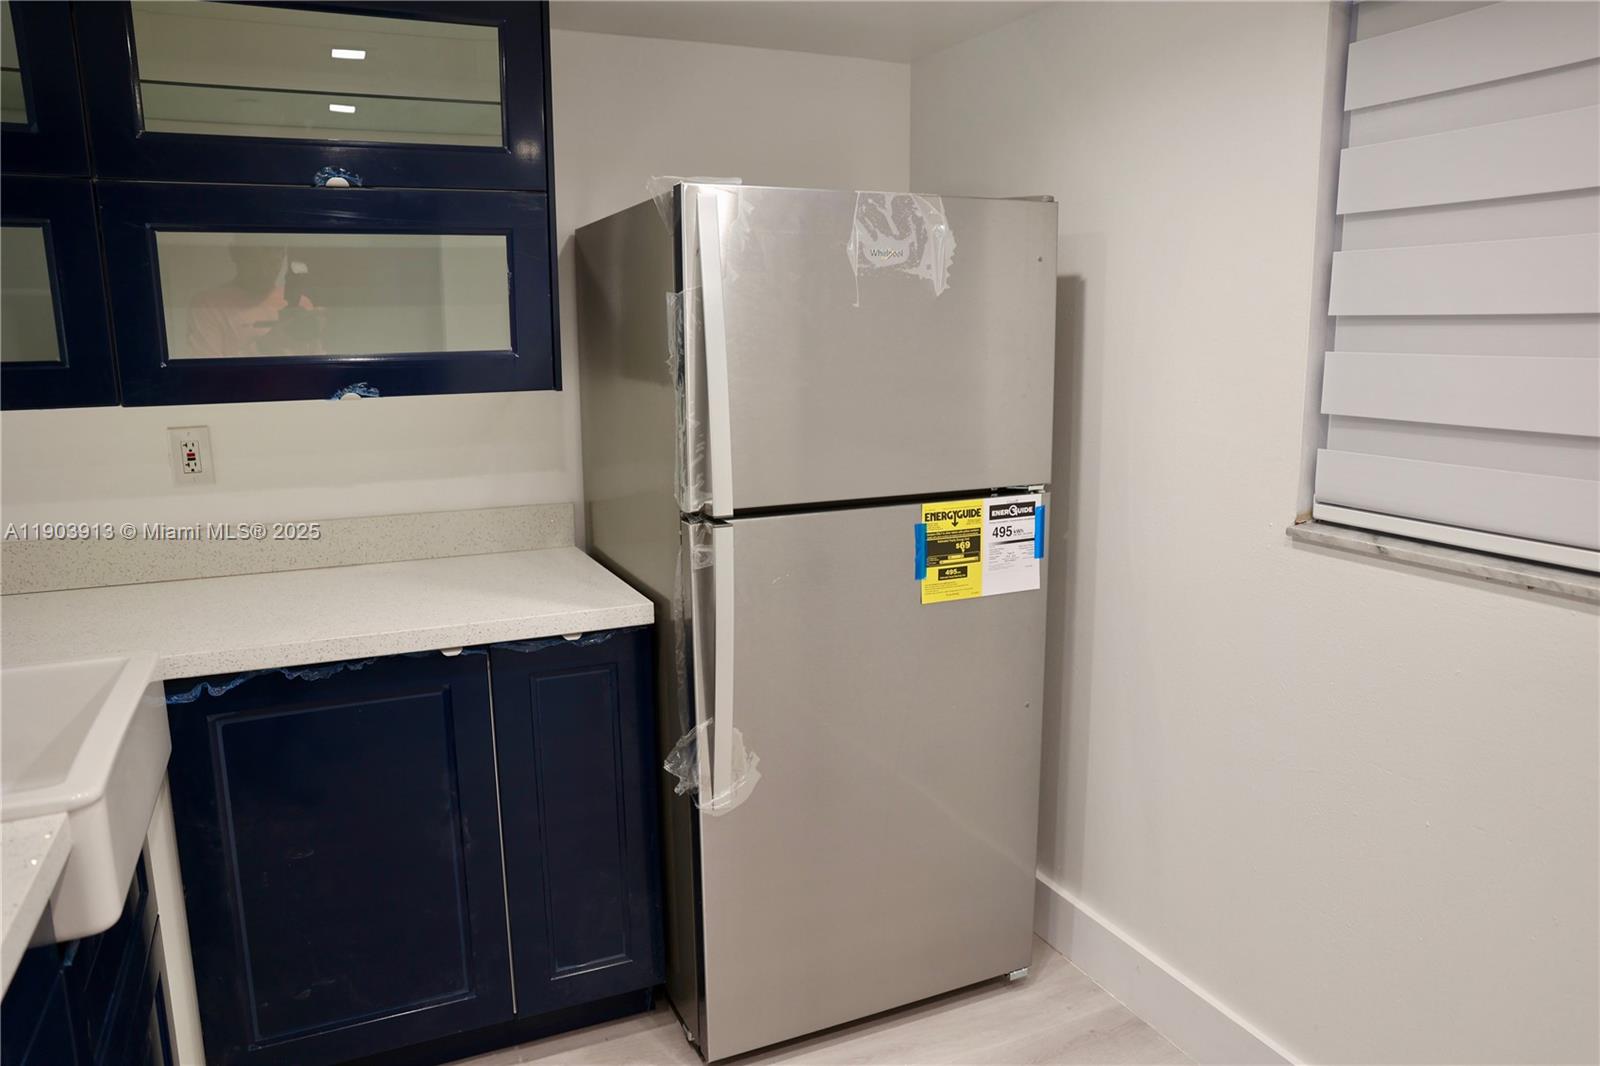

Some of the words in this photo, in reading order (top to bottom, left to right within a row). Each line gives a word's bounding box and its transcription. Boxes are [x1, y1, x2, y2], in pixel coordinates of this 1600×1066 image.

[870, 248, 904, 258] Whirlpool
[924, 508, 981, 522] ENERGYGUIDE
[991, 504, 1034, 517] ENERGUIDE
[992, 526, 1013, 538] 495
[955, 541, 971, 550] $69
